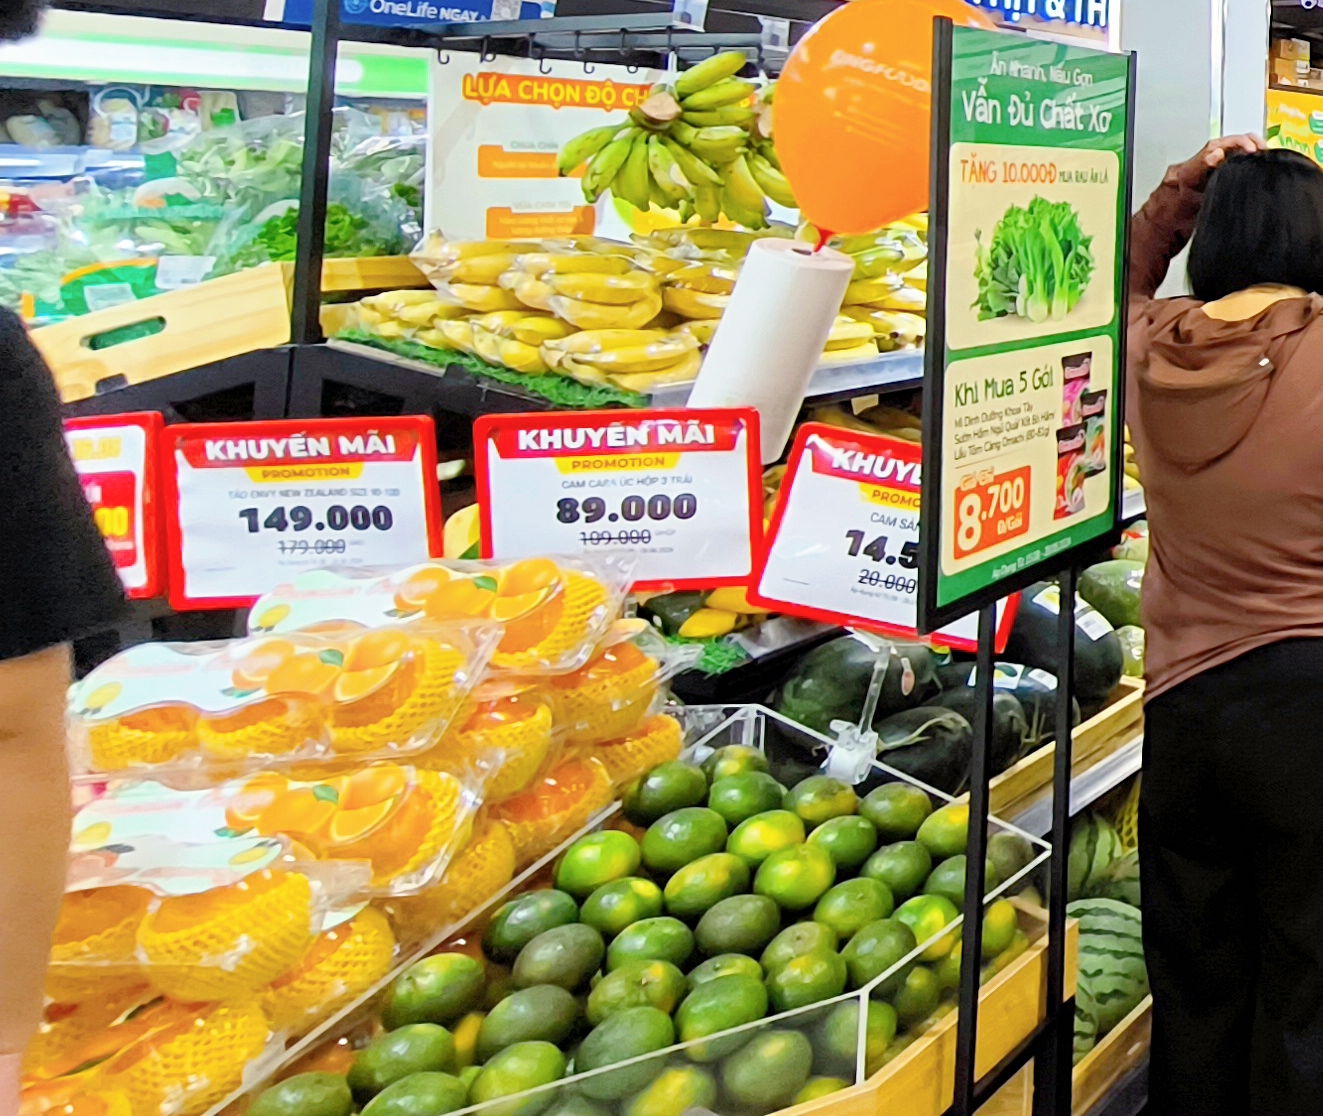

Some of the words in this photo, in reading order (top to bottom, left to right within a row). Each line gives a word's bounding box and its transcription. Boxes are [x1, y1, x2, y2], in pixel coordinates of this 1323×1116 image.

[465, 73, 510, 105] LỰA
[518, 81, 580, 110] CHỌN
[590, 78, 617, 111] ĐỘ
[961, 77, 1001, 124] Vẫn
[1008, 91, 1034, 126] Đủ
[1040, 92, 1084, 130] Chất
[1088, 104, 1112, 133] Xơ
[960, 153, 997, 188] TẶNG
[955, 381, 978, 408] Khi
[985, 377, 1014, 401] Mua
[1020, 370, 1027, 393] 5
[1032, 363, 1053, 390] Gói
[204, 431, 331, 461] KHUYẾN
[338, 430, 396, 455] MÃI
[657, 420, 715, 445] MÃI
[262, 467, 350, 479] PROMOTION
[572, 456, 665, 470] PROMOTION
[562, 480, 586, 489] CAM
[239, 505, 393, 533] 149.000
[556, 493, 697, 524] 89.000
[870, 512, 897, 527] CAM
[957, 476, 1024, 551] 8.700
[278, 539, 346, 555] 179.000
[579, 529, 652, 546] 109.000
[858, 568, 917, 594] 20.000
